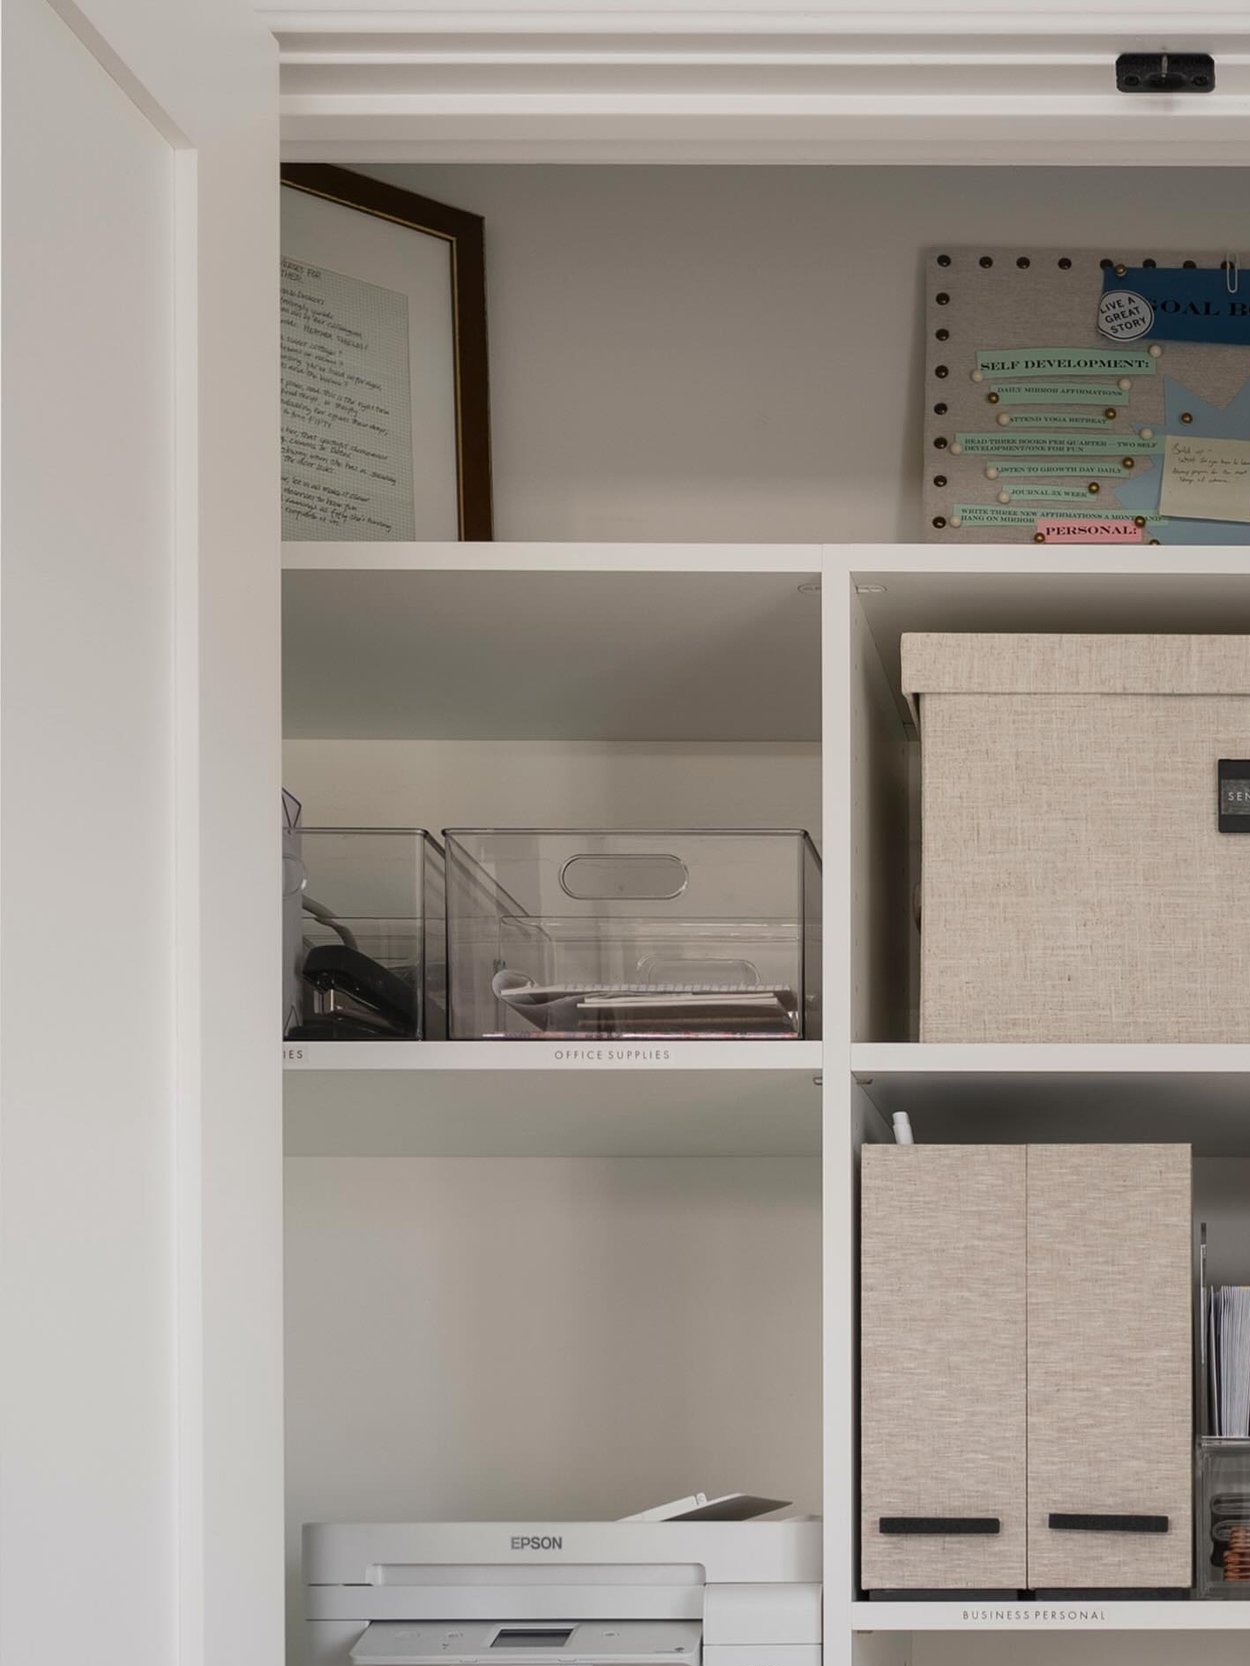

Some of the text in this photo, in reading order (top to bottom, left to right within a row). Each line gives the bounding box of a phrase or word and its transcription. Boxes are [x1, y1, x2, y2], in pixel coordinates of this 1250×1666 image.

[1100, 296, 1136, 314] LIVE A
[1105, 306, 1142, 324] GREAT
[1110, 316, 1148, 334] STORY
[981, 359, 1149, 371] SELF DEVELOPMENT:
[1061, 388, 1123, 396] AFFIRMATIONS
[1044, 416, 1067, 424] YOGA
[1111, 514, 1136, 522] MONT
[1046, 526, 1137, 536] PERSONAL:
[554, 1049, 670, 1061] OFFICE SUPPLIES
[511, 1536, 563, 1550] EPSON
[962, 1610, 1105, 1621] BUSINESS PERSONAL
